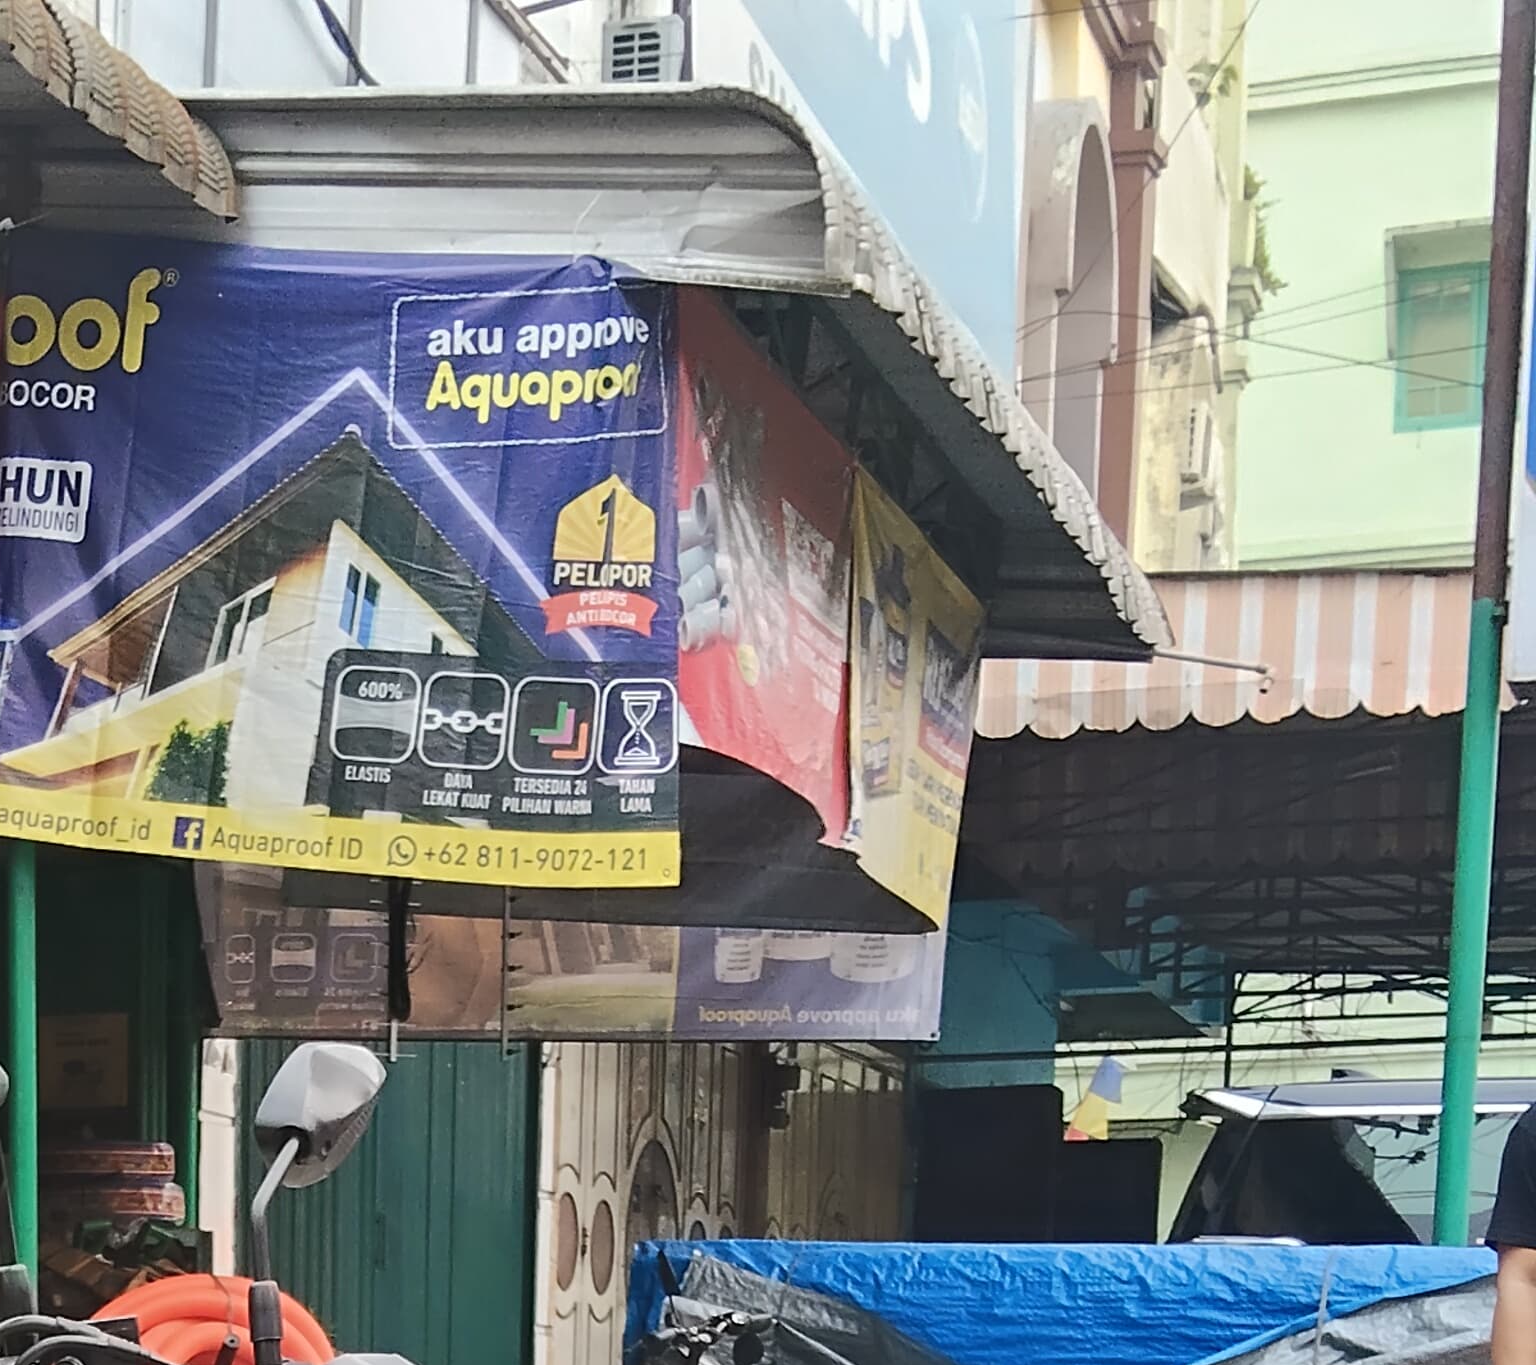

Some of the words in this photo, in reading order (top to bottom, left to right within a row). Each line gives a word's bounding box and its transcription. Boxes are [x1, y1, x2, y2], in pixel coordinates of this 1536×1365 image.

[427, 319, 504, 357] aku
[516, 315, 650, 359] approve
[357, 680, 404, 701] 600%
[344, 764, 392, 785] ELASTIS
[513, 776, 572, 796] TERSEDIA
[618, 777, 657, 795] TAHAN
[422, 789, 460, 808] LEKAT
[501, 797, 552, 815] PILIHAN
[619, 797, 653, 814] LAMA
[210, 826, 335, 861] Aquaproof
[339, 836, 364, 861] ID
[423, 844, 470, 867] +62
[476, 846, 648, 872] 811-9072-121
